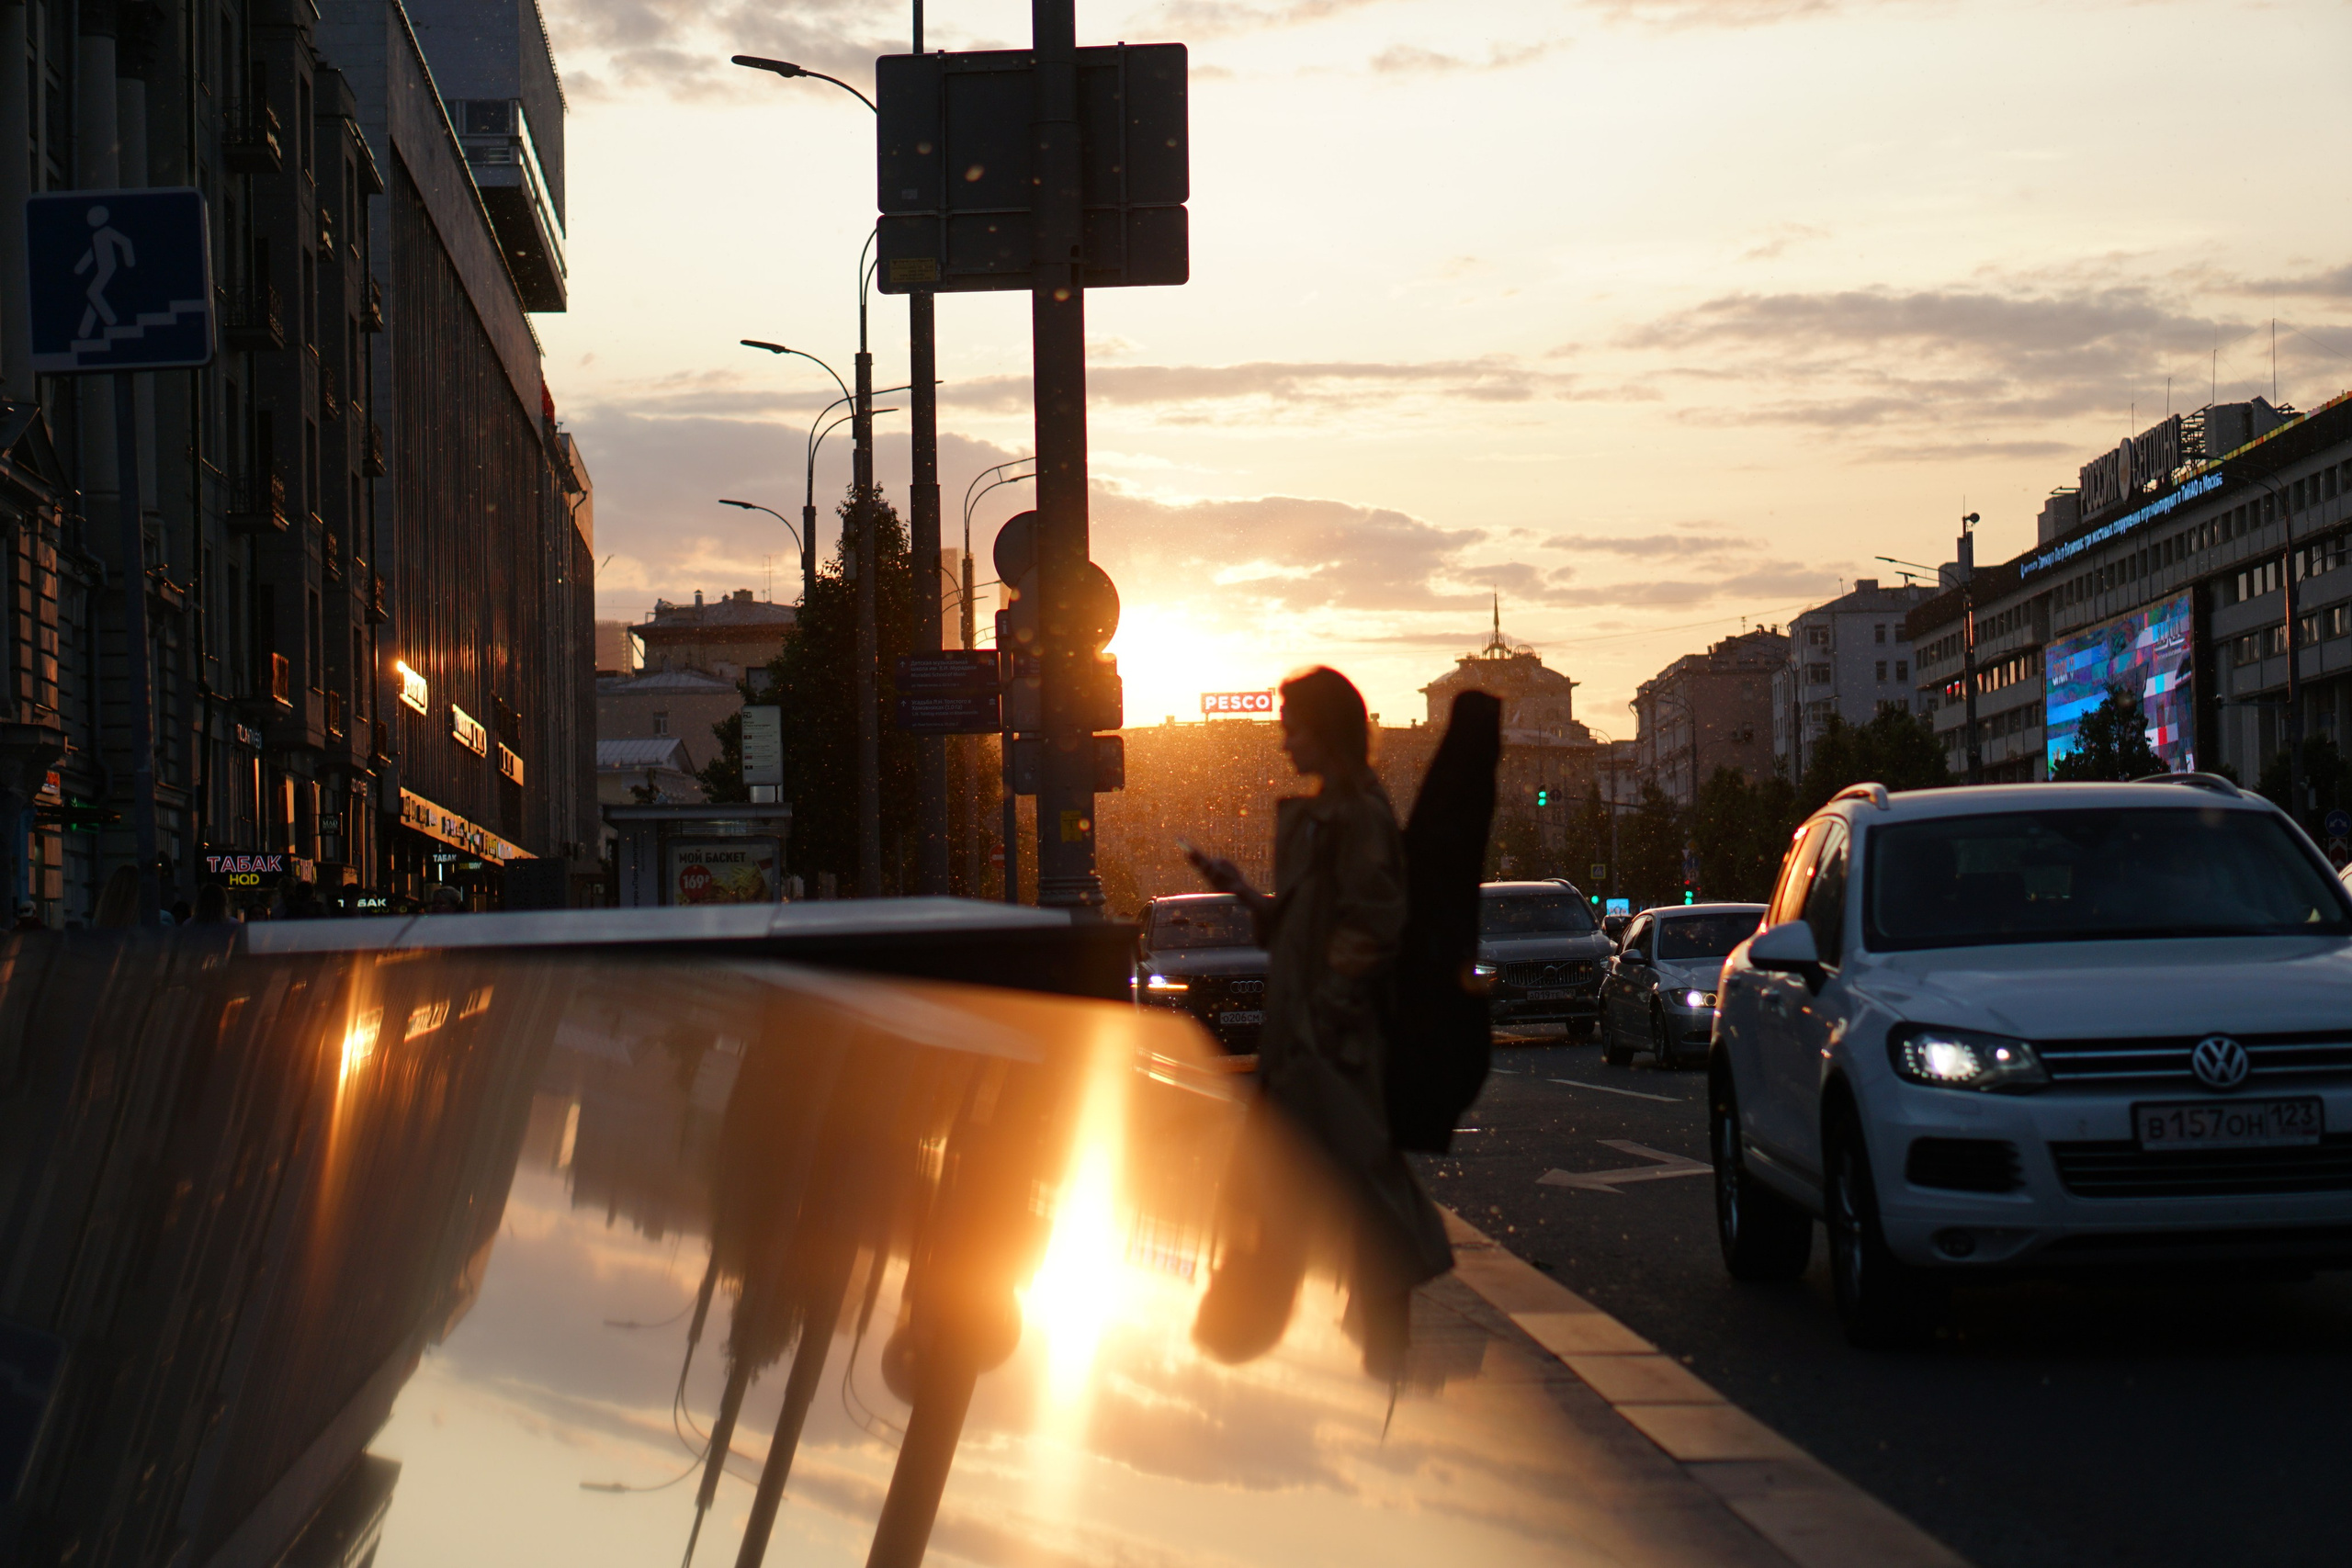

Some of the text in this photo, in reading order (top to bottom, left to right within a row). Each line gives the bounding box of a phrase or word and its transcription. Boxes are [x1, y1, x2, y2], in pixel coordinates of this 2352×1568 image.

[2080, 413, 2181, 516] РОССИЯ СЕГОДНЯ
[2181, 479, 2199, 502] ТиНАО
[1204, 694, 1270, 710] PESCO
[207, 854, 283, 873] ТАБАК
[433, 853, 458, 863] ТАБАК
[678, 849, 746, 863] МОЙ БАСКЕТ
[229, 874, 260, 886] HQD
[337, 897, 387, 908] ТБАК
[2270, 1103, 2314, 1126] 123
